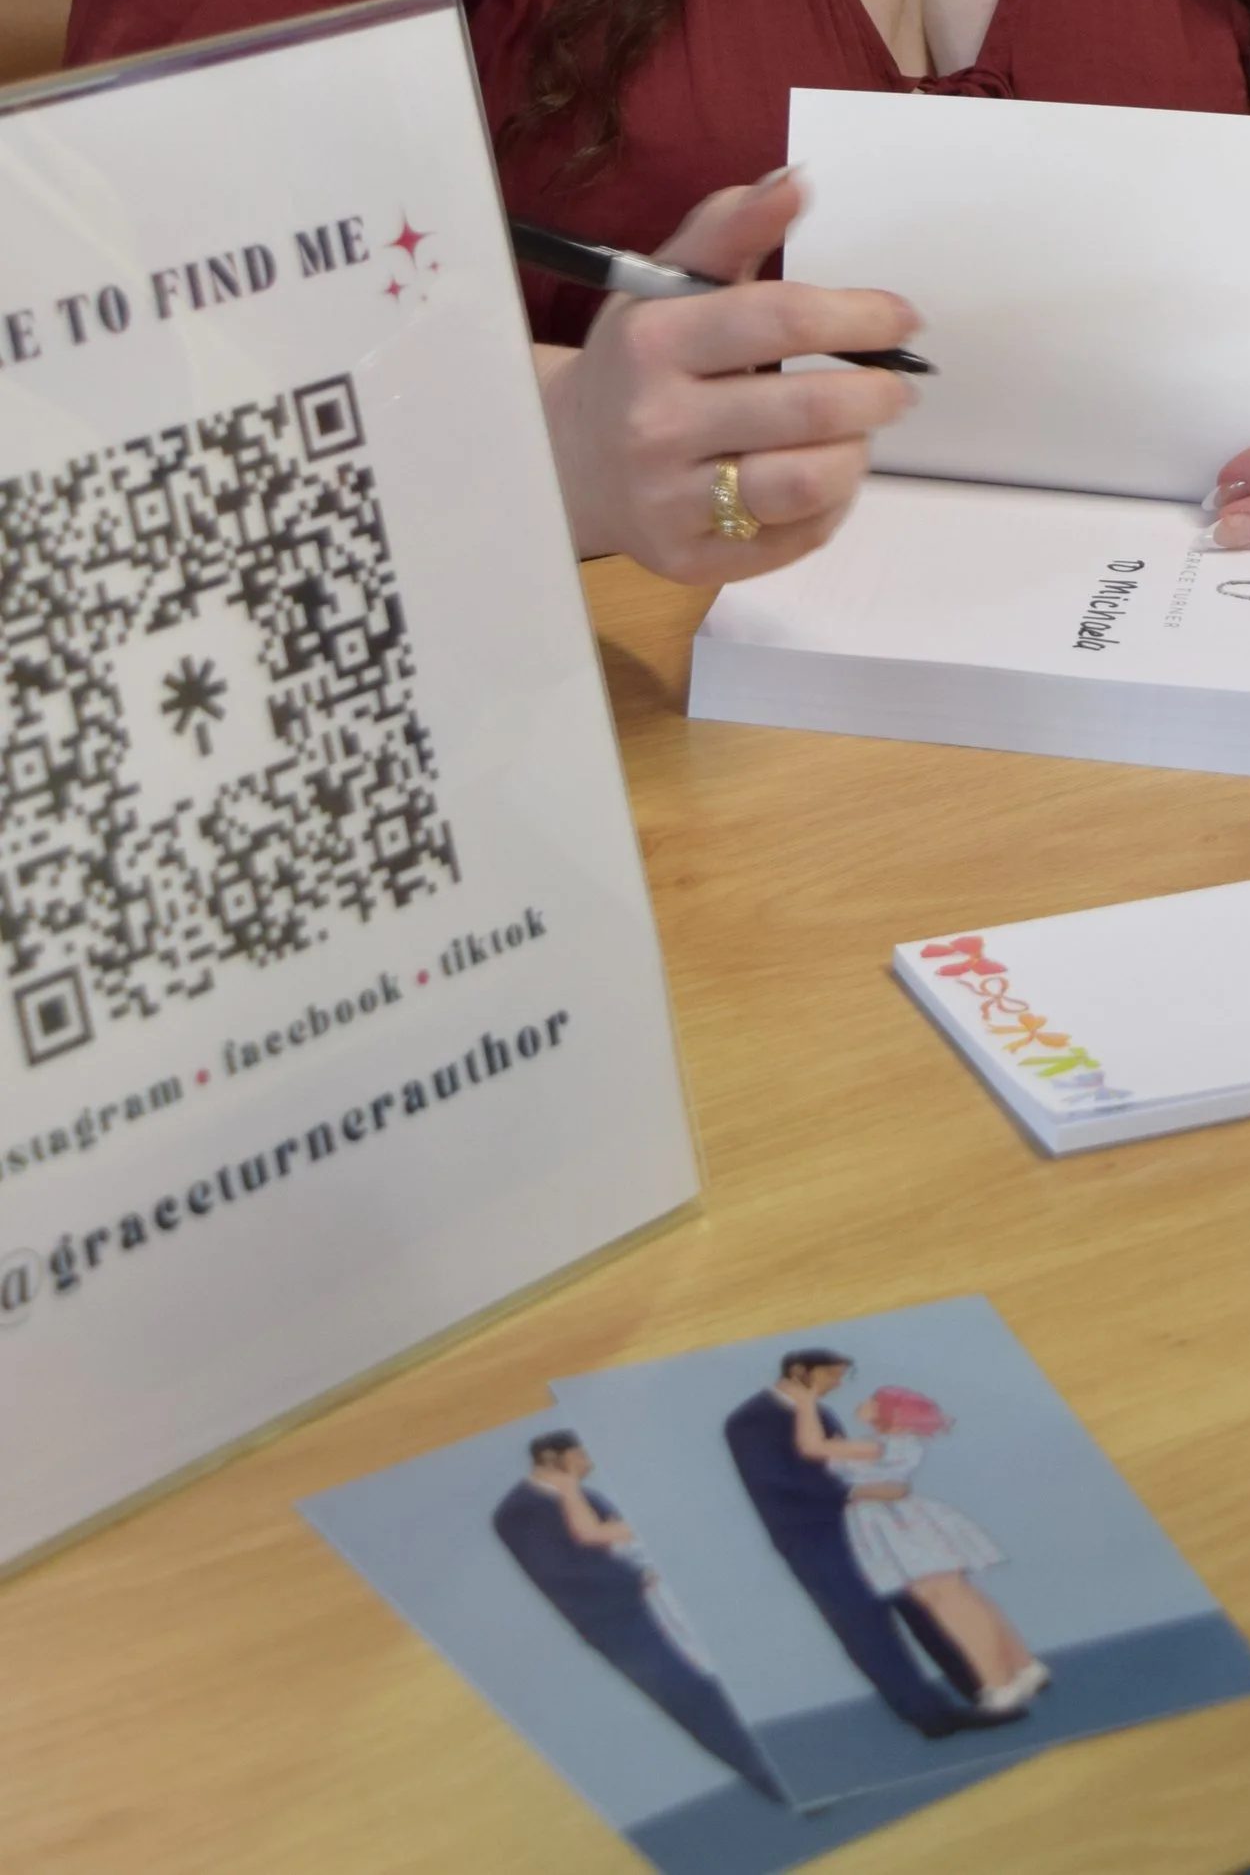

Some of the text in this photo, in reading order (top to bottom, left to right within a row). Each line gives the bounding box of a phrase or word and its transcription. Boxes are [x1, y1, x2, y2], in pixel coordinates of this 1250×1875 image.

[55, 284, 131, 347] TO
[150, 242, 278, 321] FIND
[294, 215, 371, 279] ME
[1072, 579, 1139, 652] Michaela
[1163, 550, 1204, 629] GRACE TURNER
[221, 970, 404, 1077] facebook
[438, 906, 549, 980] tiktok
[0, 1005, 574, 1329] @graceturnerauthor
